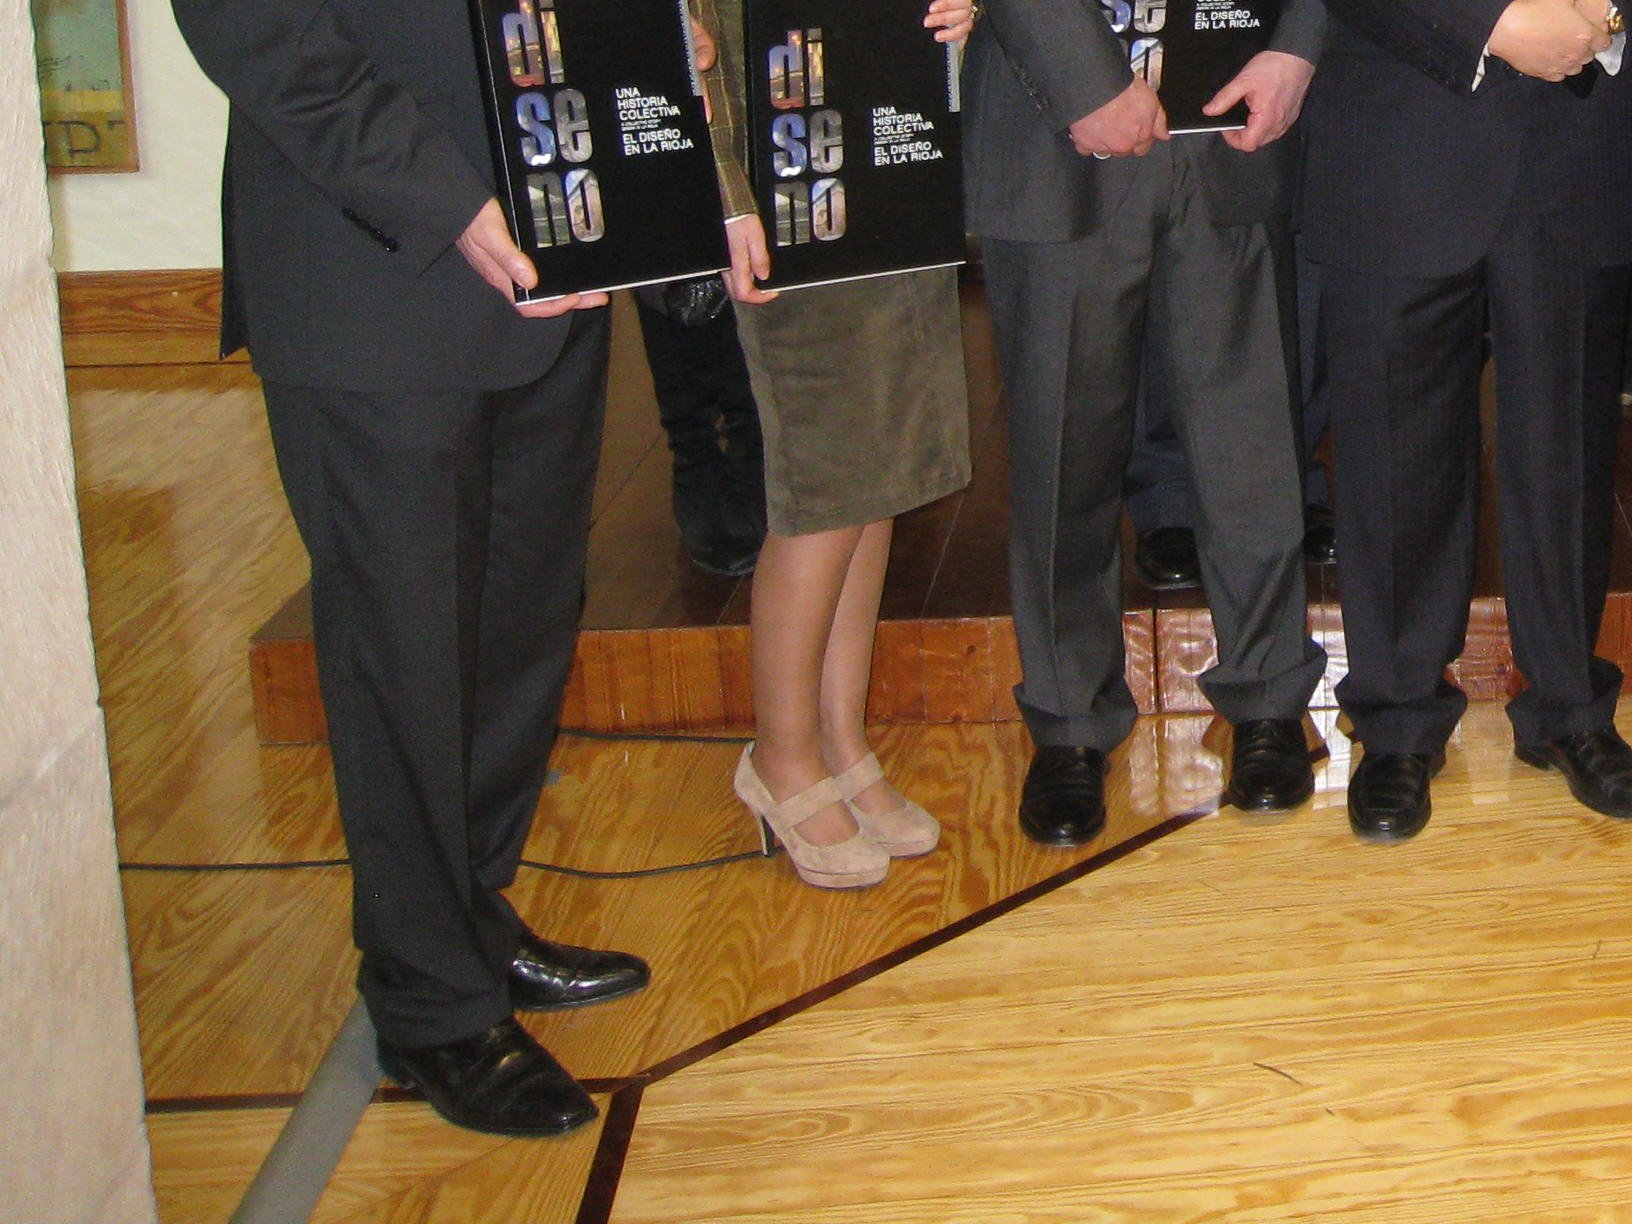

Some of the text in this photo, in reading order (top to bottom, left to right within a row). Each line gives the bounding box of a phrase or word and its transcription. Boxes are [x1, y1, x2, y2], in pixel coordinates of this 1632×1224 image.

[1195, 12, 1209, 21] EL
[1194, 18, 1261, 30] EN LA RIOJA
[615, 87, 640, 98] UNA
[617, 96, 668, 110] HISTORIA
[619, 105, 681, 121] COLECTIVA
[872, 106, 897, 116] UNA
[873, 113, 923, 126] HISTORIA
[873, 121, 935, 136] COLECTIVA
[622, 134, 637, 144] EL
[624, 138, 694, 156] EN LA RIOJA
[874, 147, 888, 157] EL
[874, 150, 944, 166] EN LA RIOJA
